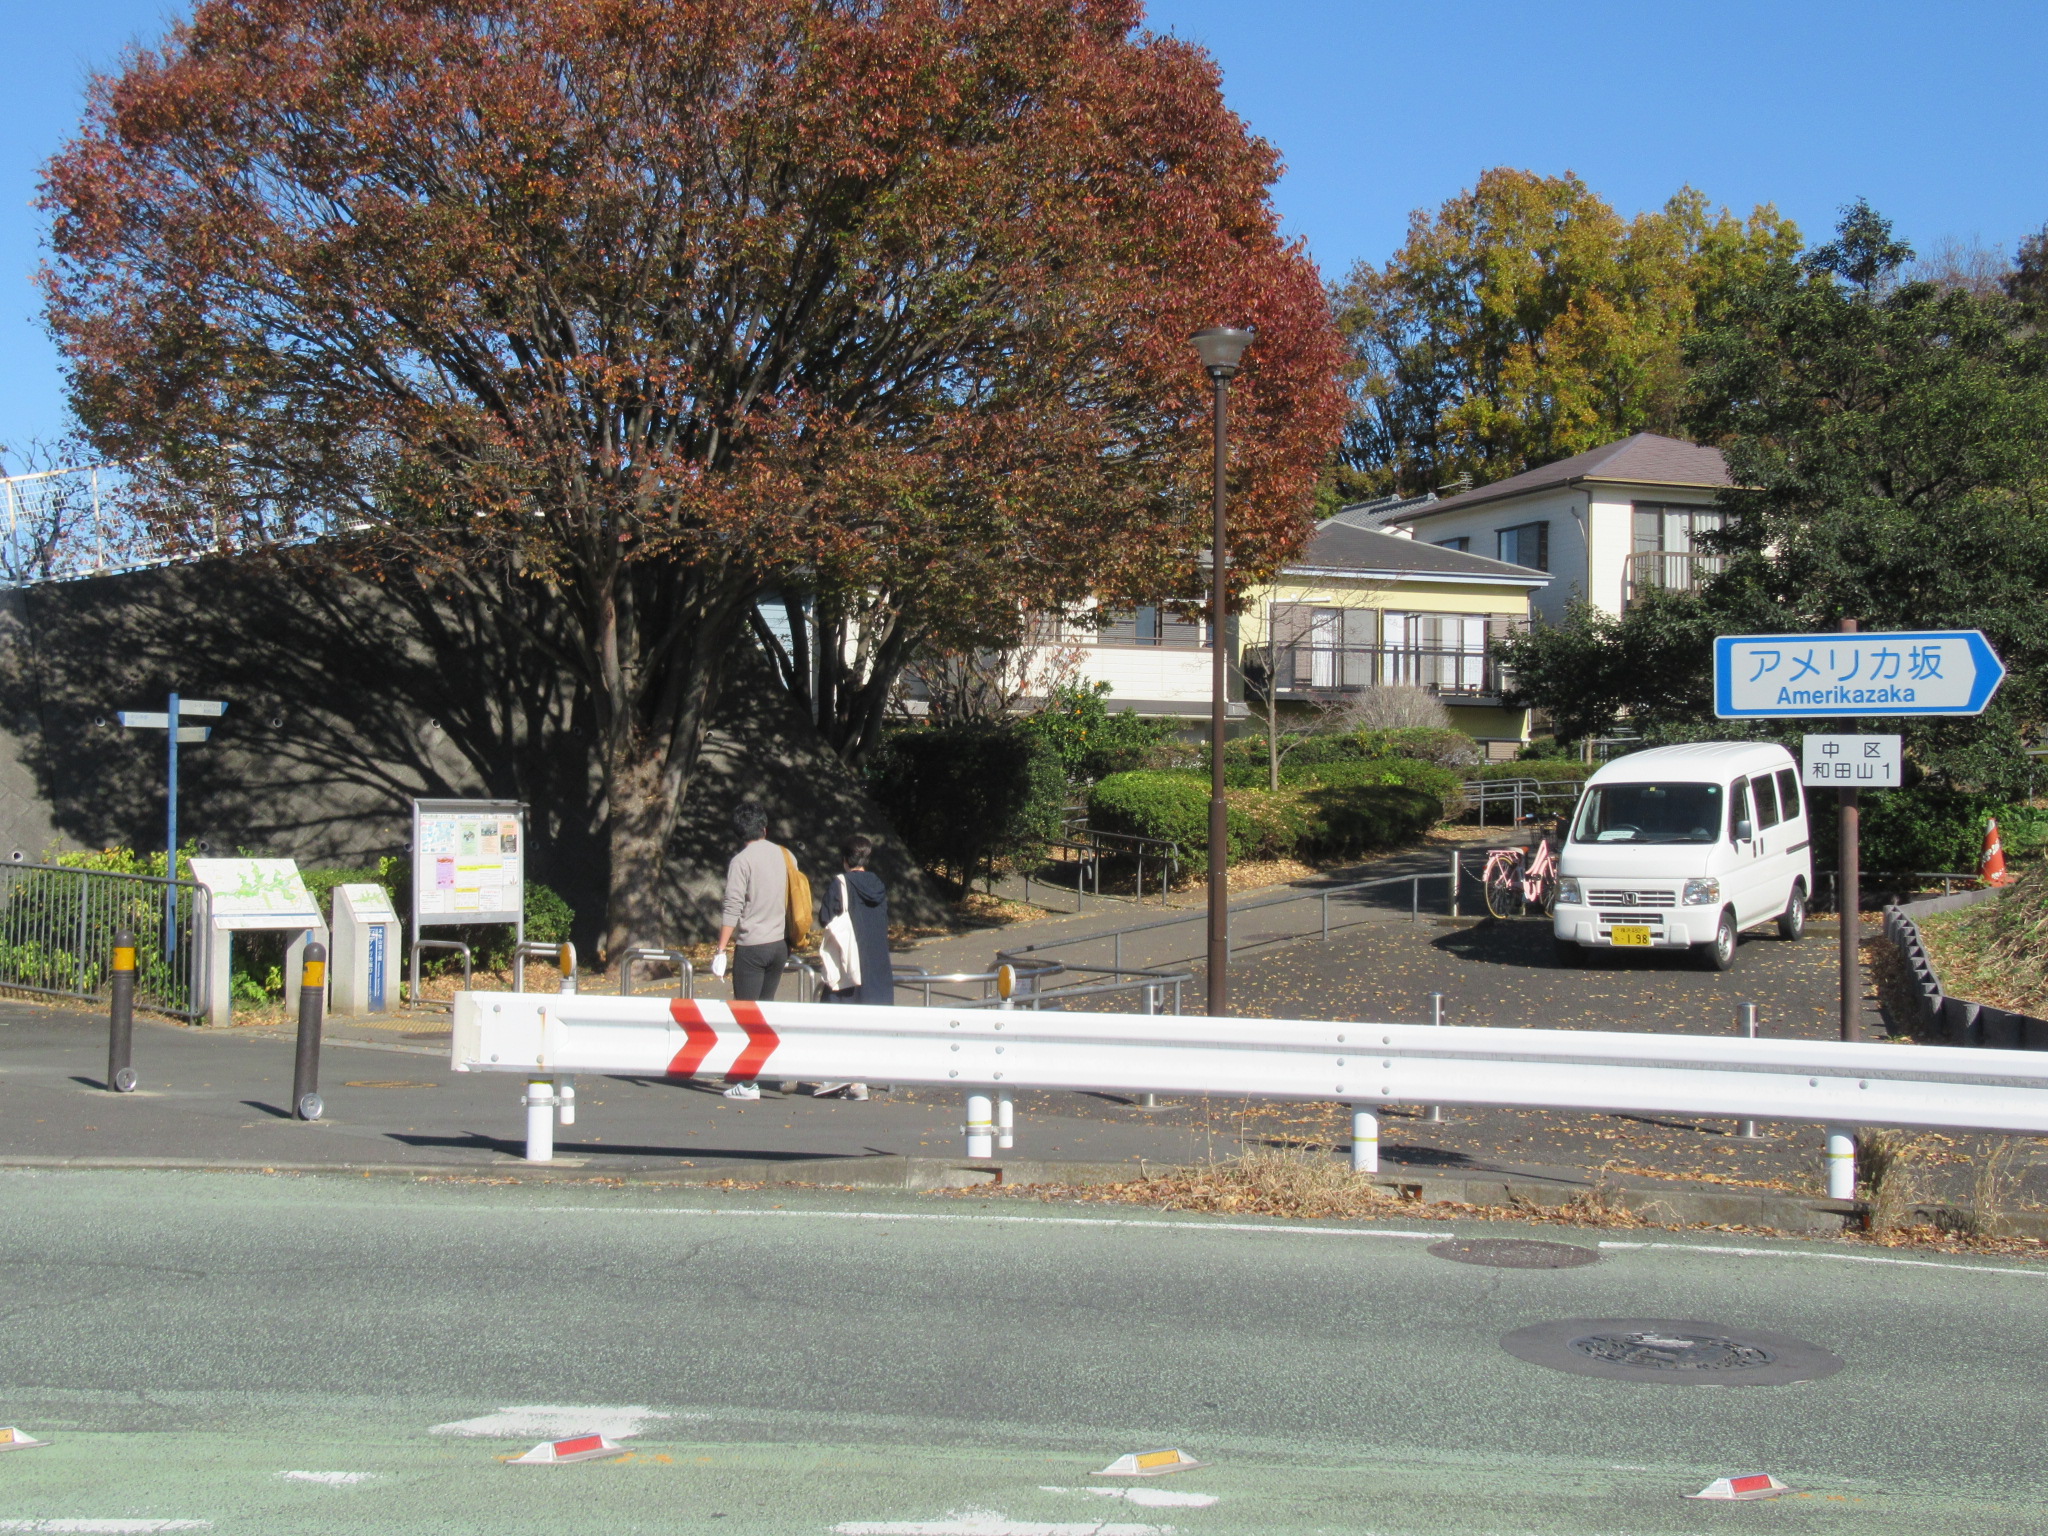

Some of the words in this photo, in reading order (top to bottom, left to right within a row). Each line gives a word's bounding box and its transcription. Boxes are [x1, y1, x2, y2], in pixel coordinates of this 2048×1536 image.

[1749, 645, 1943, 682] アメリカ坂
[1777, 684, 1916, 705] Amerikazaka
[1812, 762, 1891, 780] 和田山1
